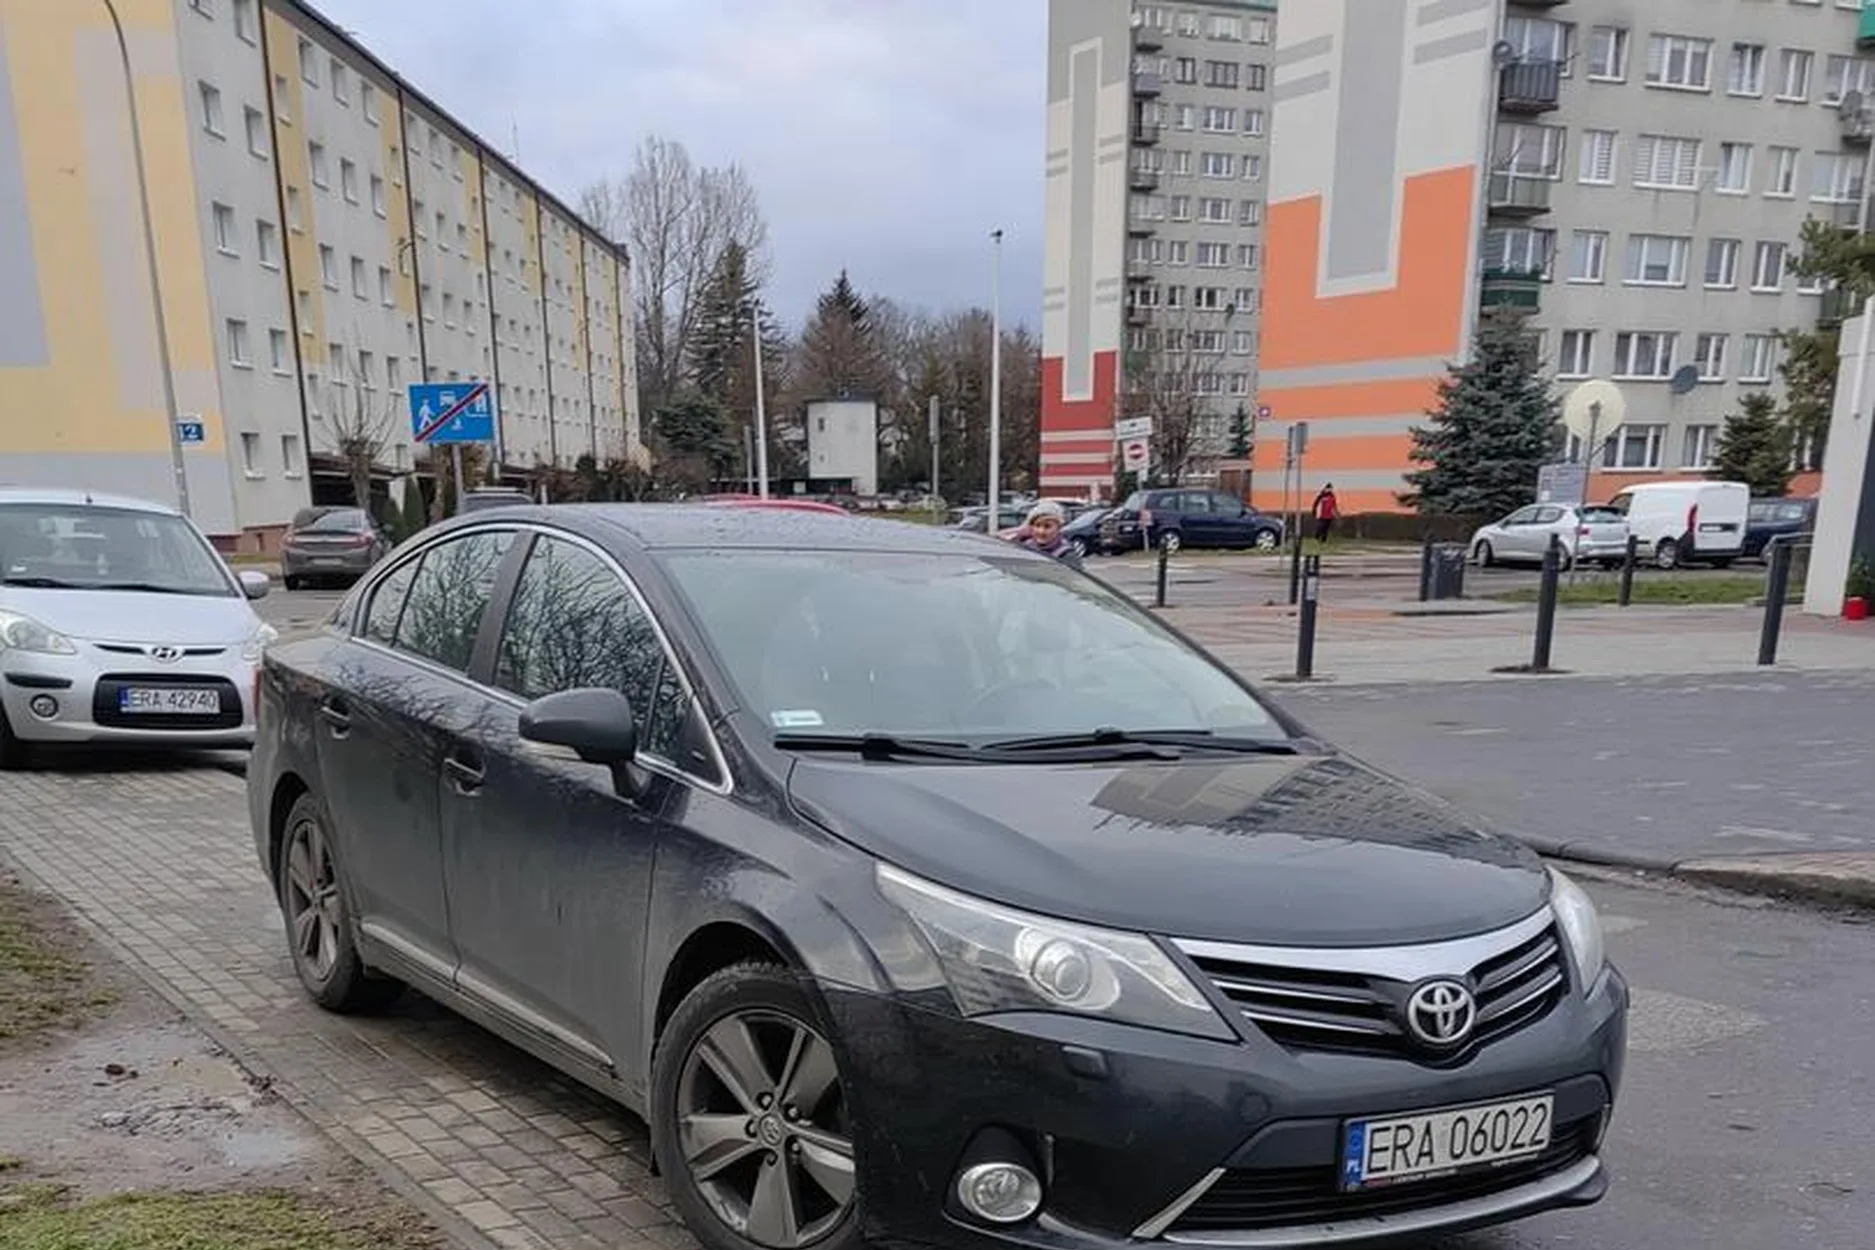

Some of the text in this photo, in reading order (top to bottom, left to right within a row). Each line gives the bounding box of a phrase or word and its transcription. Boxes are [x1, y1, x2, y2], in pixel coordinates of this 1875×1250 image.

[130, 690, 217, 709] ERA 42940
[1368, 1103, 1549, 1174] ERA 06022
